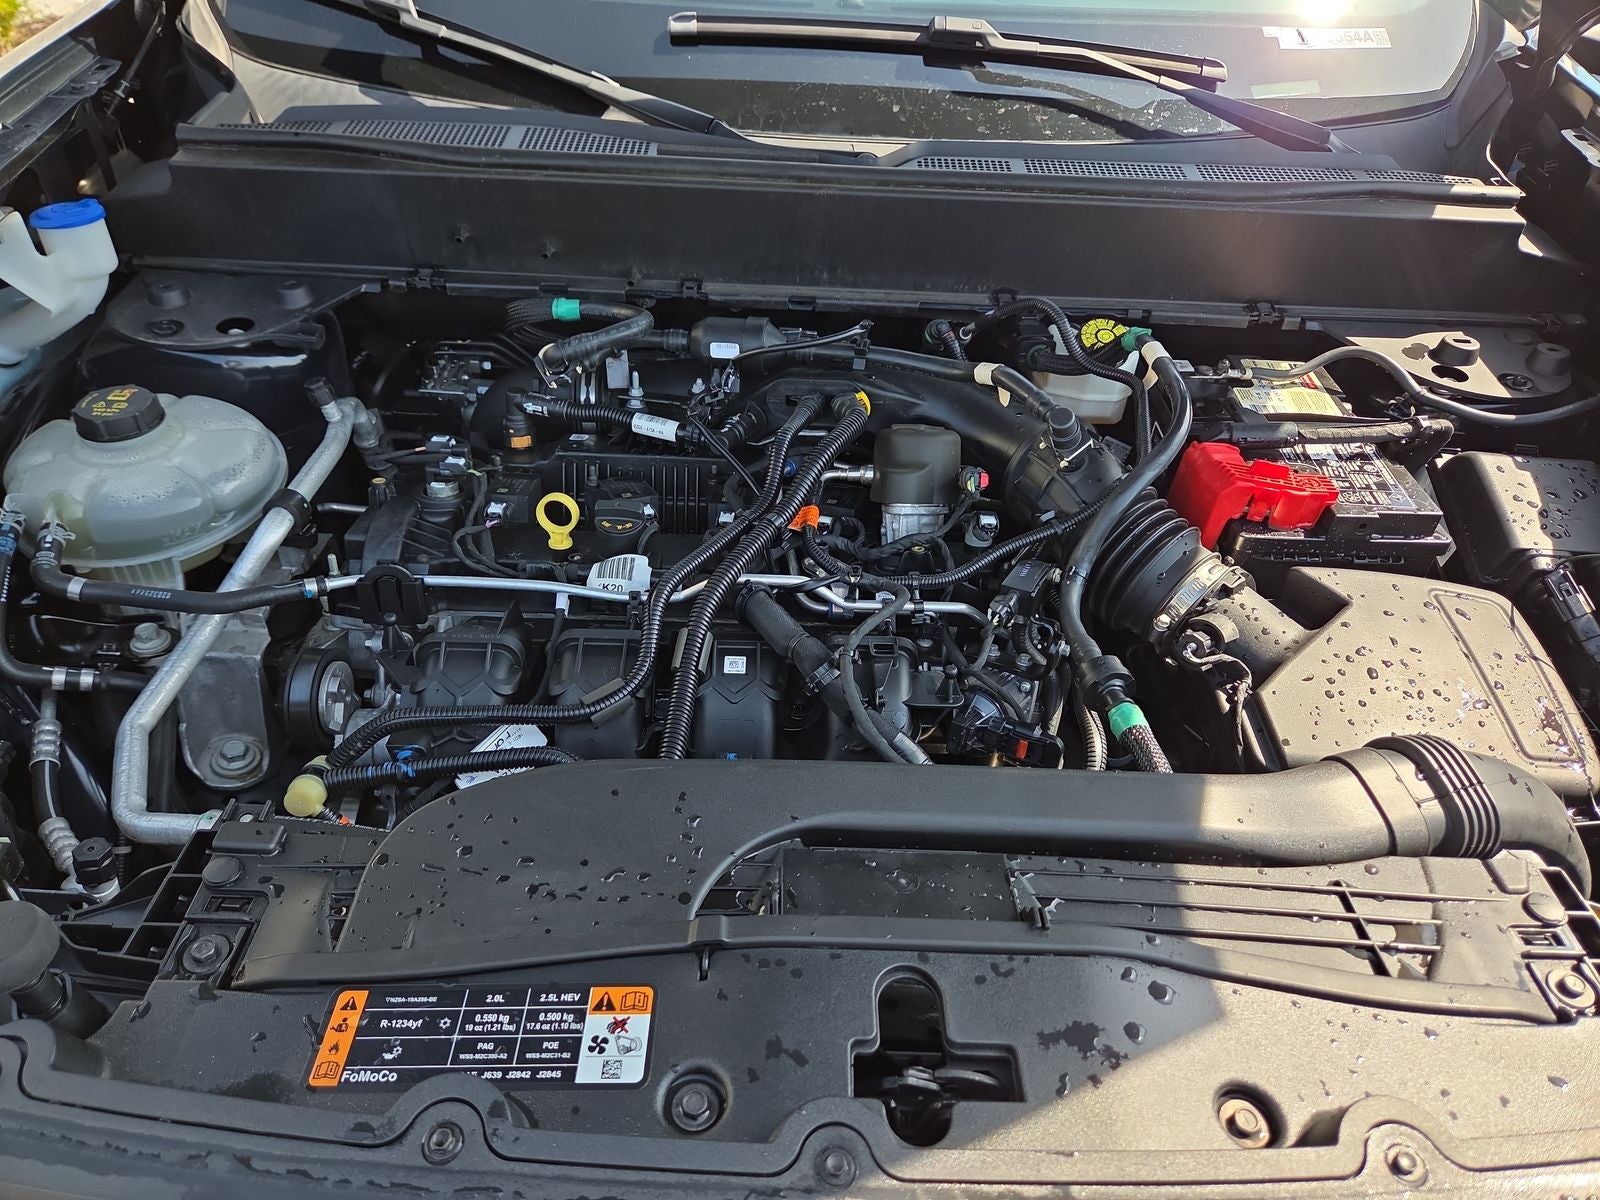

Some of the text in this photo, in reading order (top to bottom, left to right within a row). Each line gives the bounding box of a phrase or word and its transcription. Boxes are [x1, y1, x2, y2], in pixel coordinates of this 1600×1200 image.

[598, 583, 624, 593] K20
[485, 994, 506, 1003] 2.0L
[539, 992, 581, 1002] 2.5L HEV
[475, 1013, 510, 1024] 0.550 kg
[538, 1012, 574, 1023] 0.500 kg
[380, 1018, 424, 1030] R-1234yf
[484, 1023, 501, 1032] (1.21
[501, 1023, 517, 1032] lbs)
[526, 1022, 541, 1030] 17.6
[551, 1022, 568, 1031] (1.10
[568, 1022, 584, 1031] lbs)
[476, 1042, 495, 1050] PAG
[542, 1041, 560, 1050] POE
[340, 1070, 398, 1082] FoMoCo
[480, 1070, 503, 1079] J639
[505, 1070, 532, 1079] J2842
[535, 1070, 562, 1079] J2845
